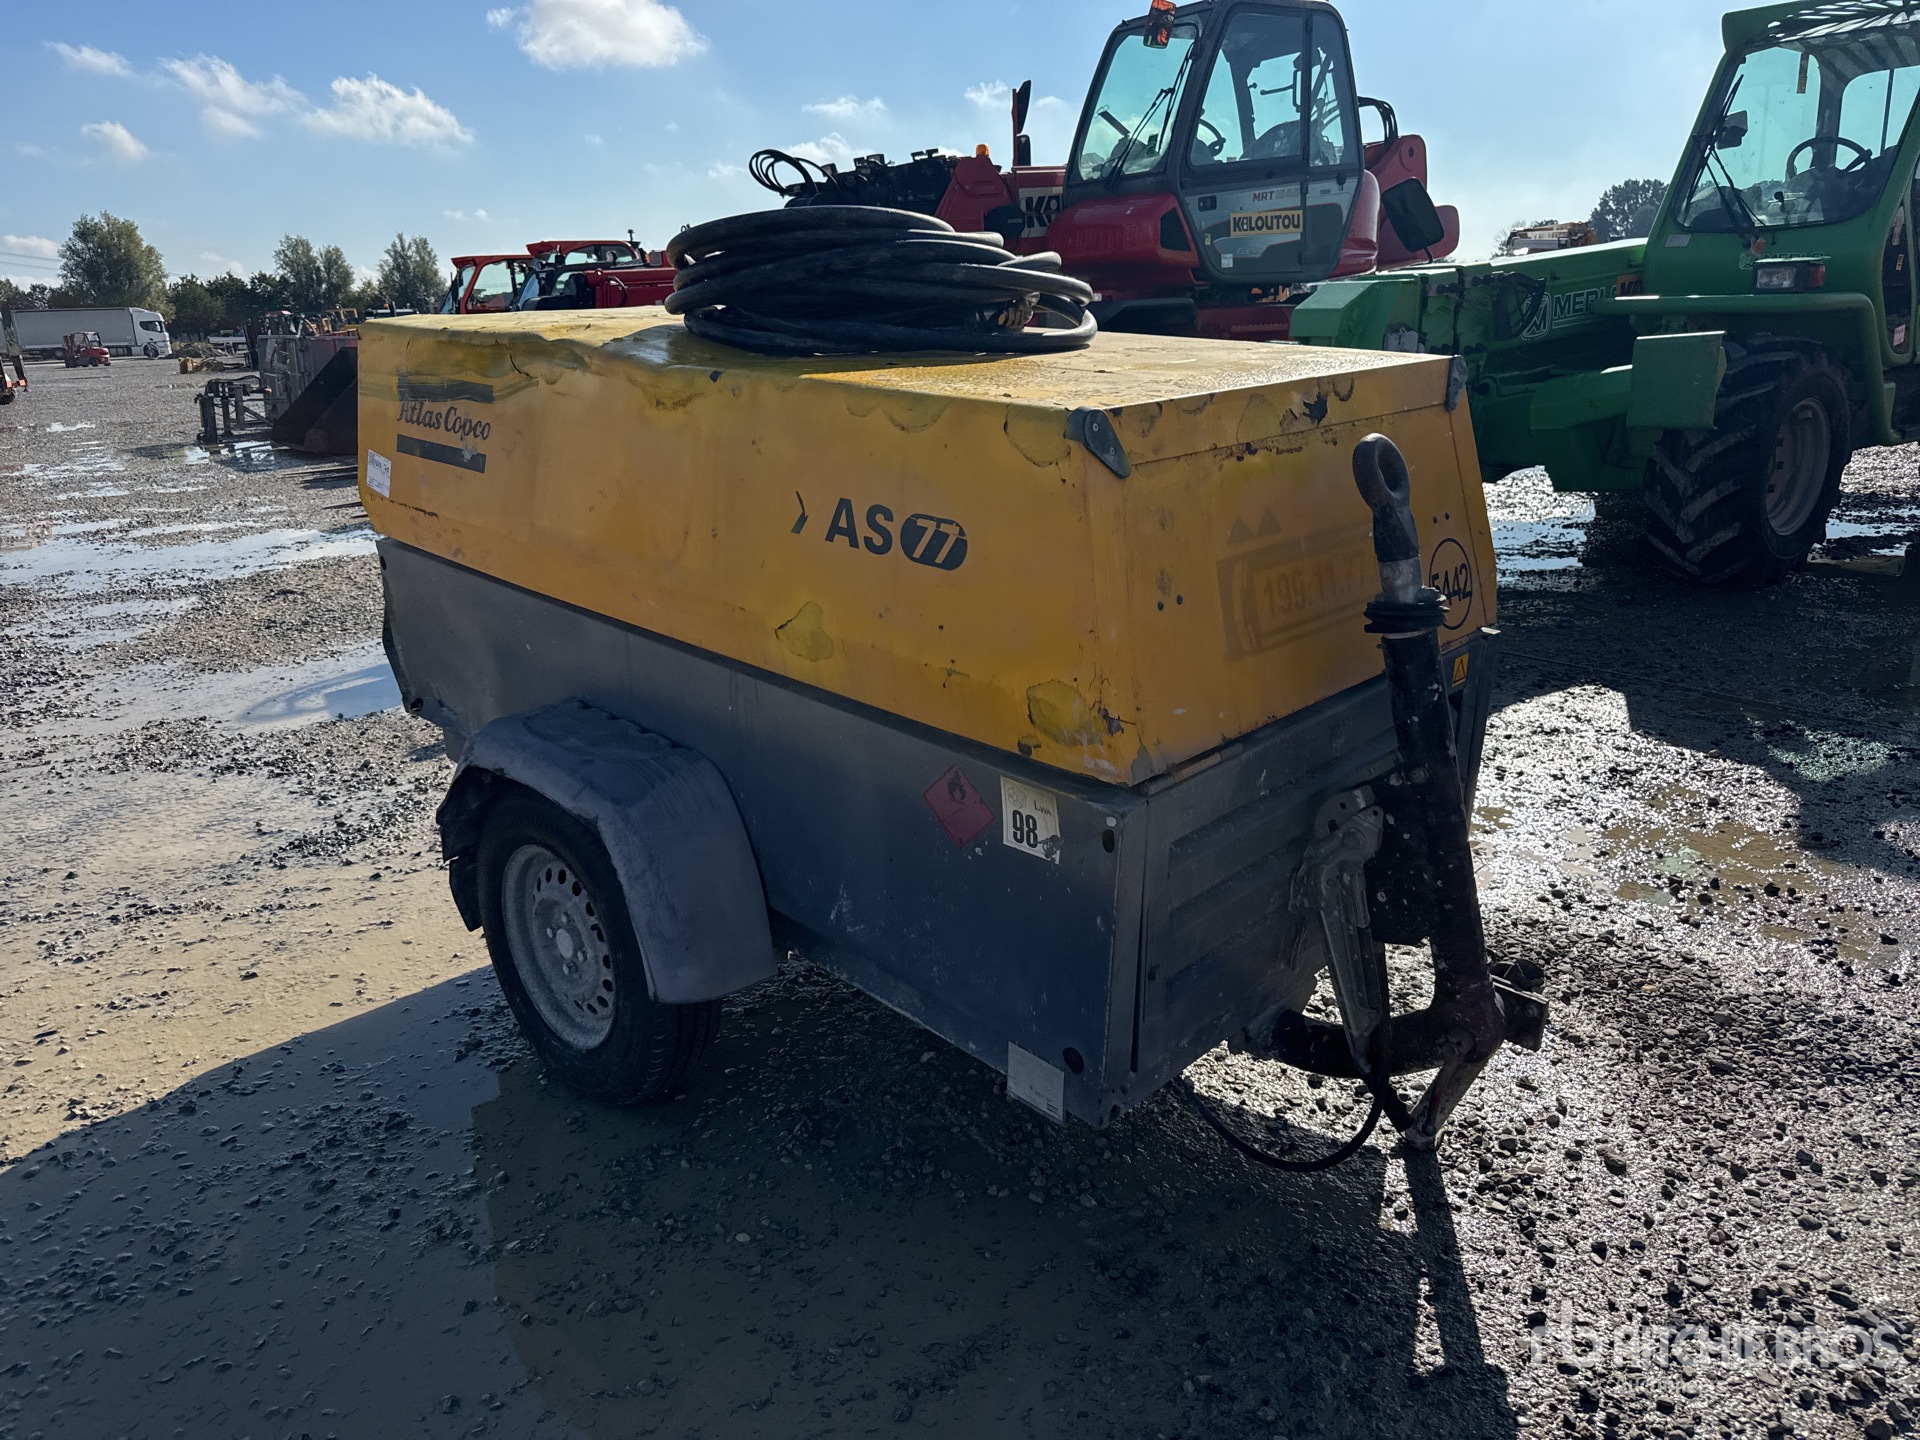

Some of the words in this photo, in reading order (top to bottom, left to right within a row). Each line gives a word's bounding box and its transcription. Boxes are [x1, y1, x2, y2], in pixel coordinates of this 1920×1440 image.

[1252, 191, 1274, 202] MRT
[1552, 285, 1617, 319] MER
[397, 402, 442, 430] Atlas
[444, 406, 491, 441] Copco
[1431, 563, 1472, 606] 5442
[1012, 809, 1038, 849] 98
